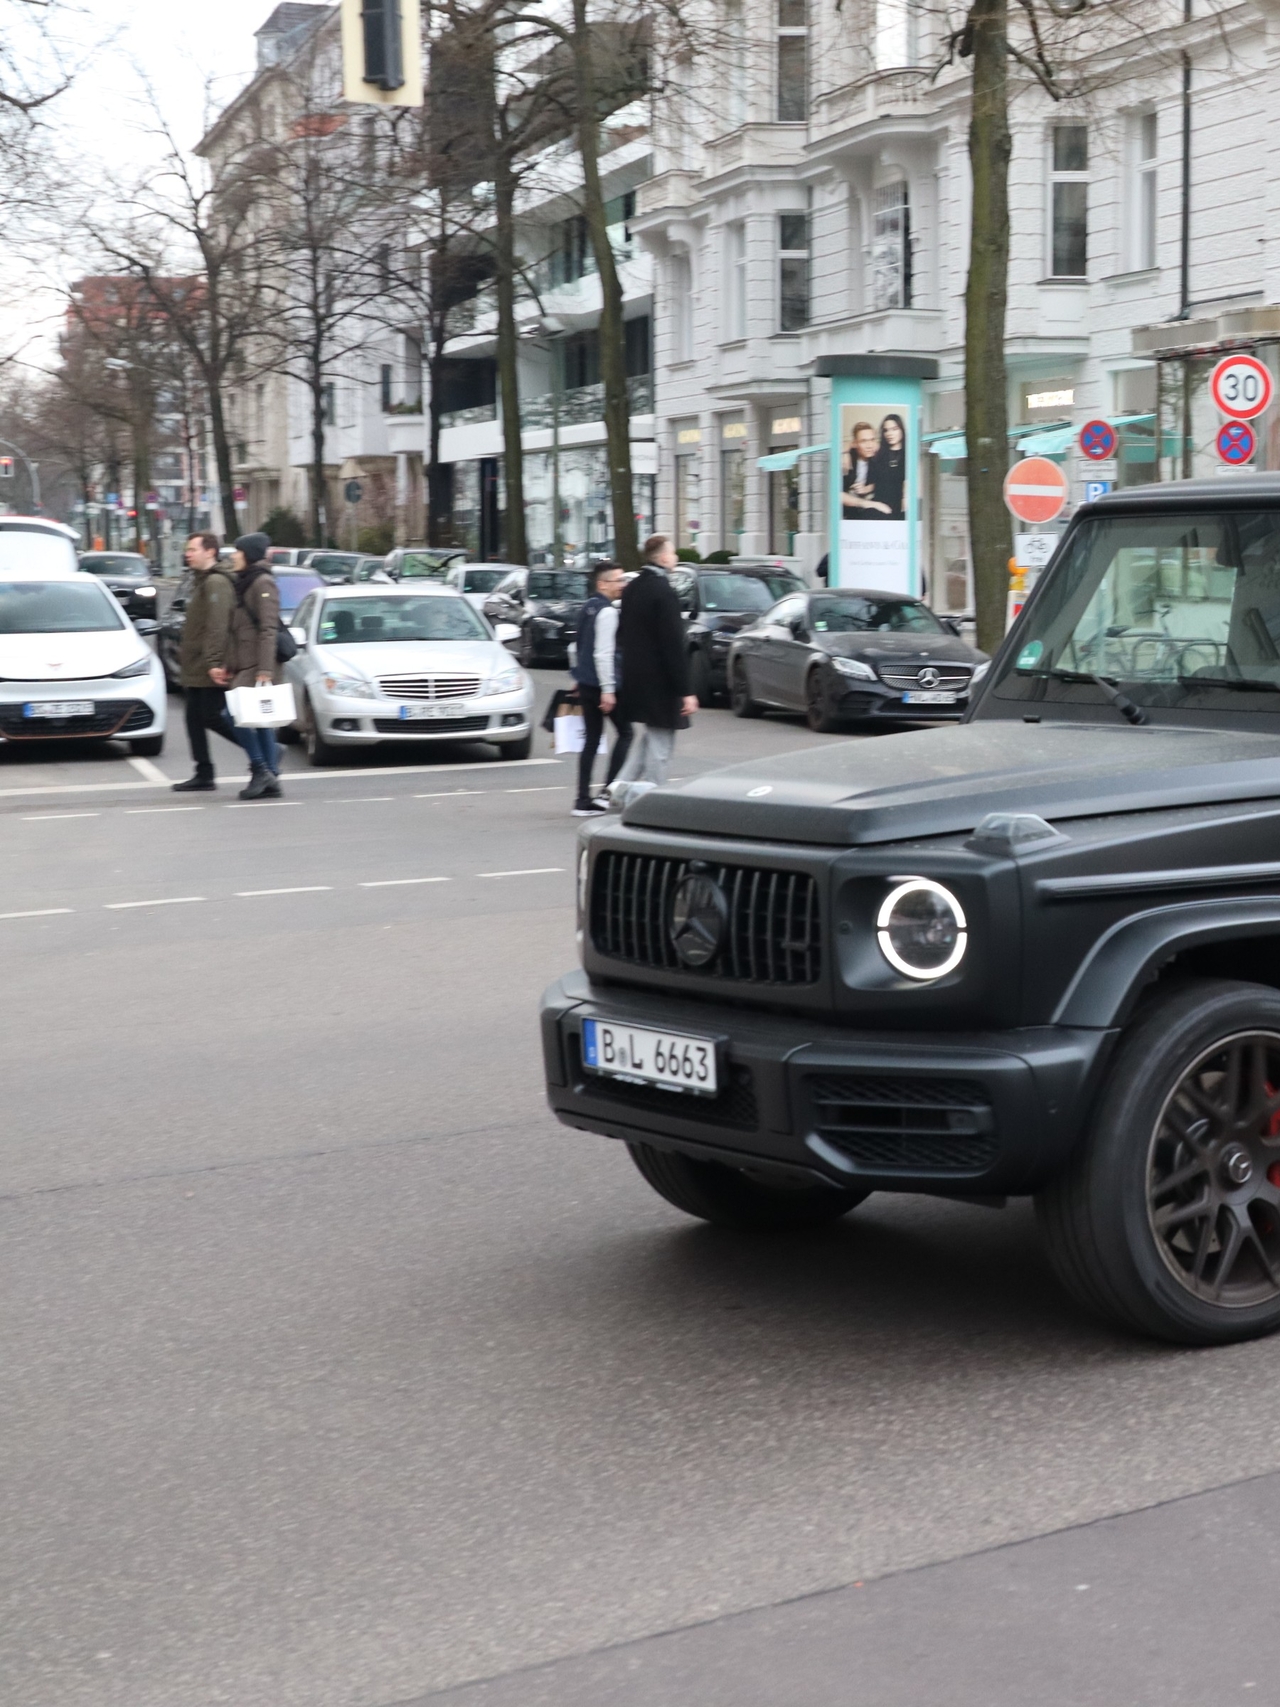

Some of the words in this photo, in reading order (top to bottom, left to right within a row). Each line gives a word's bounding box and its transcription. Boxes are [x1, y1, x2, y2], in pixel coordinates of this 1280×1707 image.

[1224, 373, 1258, 402] 30
[1088, 483, 1104, 502] P
[602, 1028, 616, 1063] B
[629, 1033, 643, 1069] L
[655, 1039, 709, 1082] 6663
